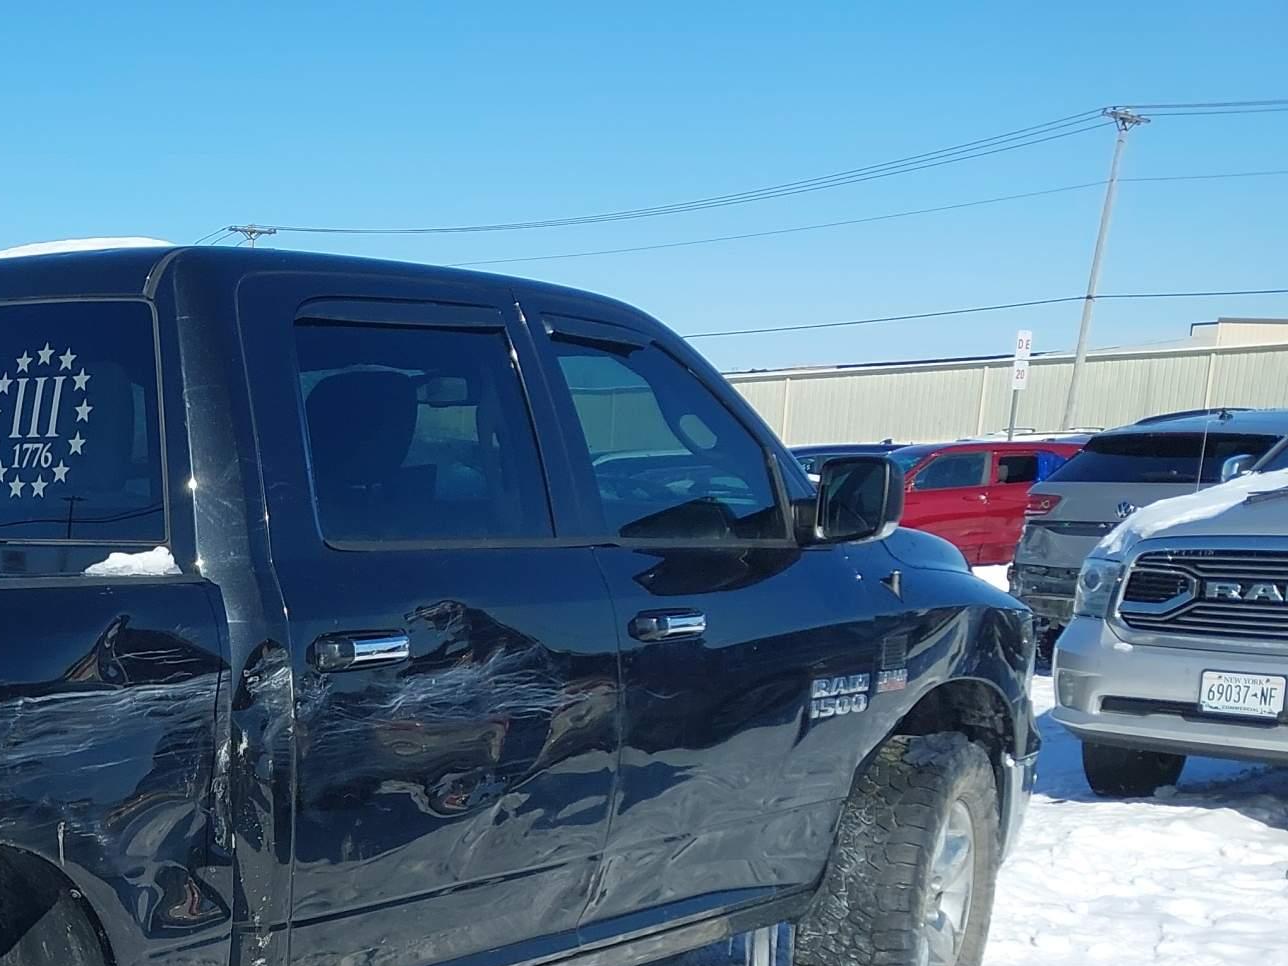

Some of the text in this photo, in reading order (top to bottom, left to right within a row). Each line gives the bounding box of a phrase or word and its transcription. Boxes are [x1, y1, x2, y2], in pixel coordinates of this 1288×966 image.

[8, 376, 67, 438] III
[11, 442, 53, 468] 1776
[1206, 581, 1288, 602] RA
[812, 673, 870, 698] RAM
[1224, 676, 1265, 686] NEW YORK
[810, 694, 869, 719] 1500
